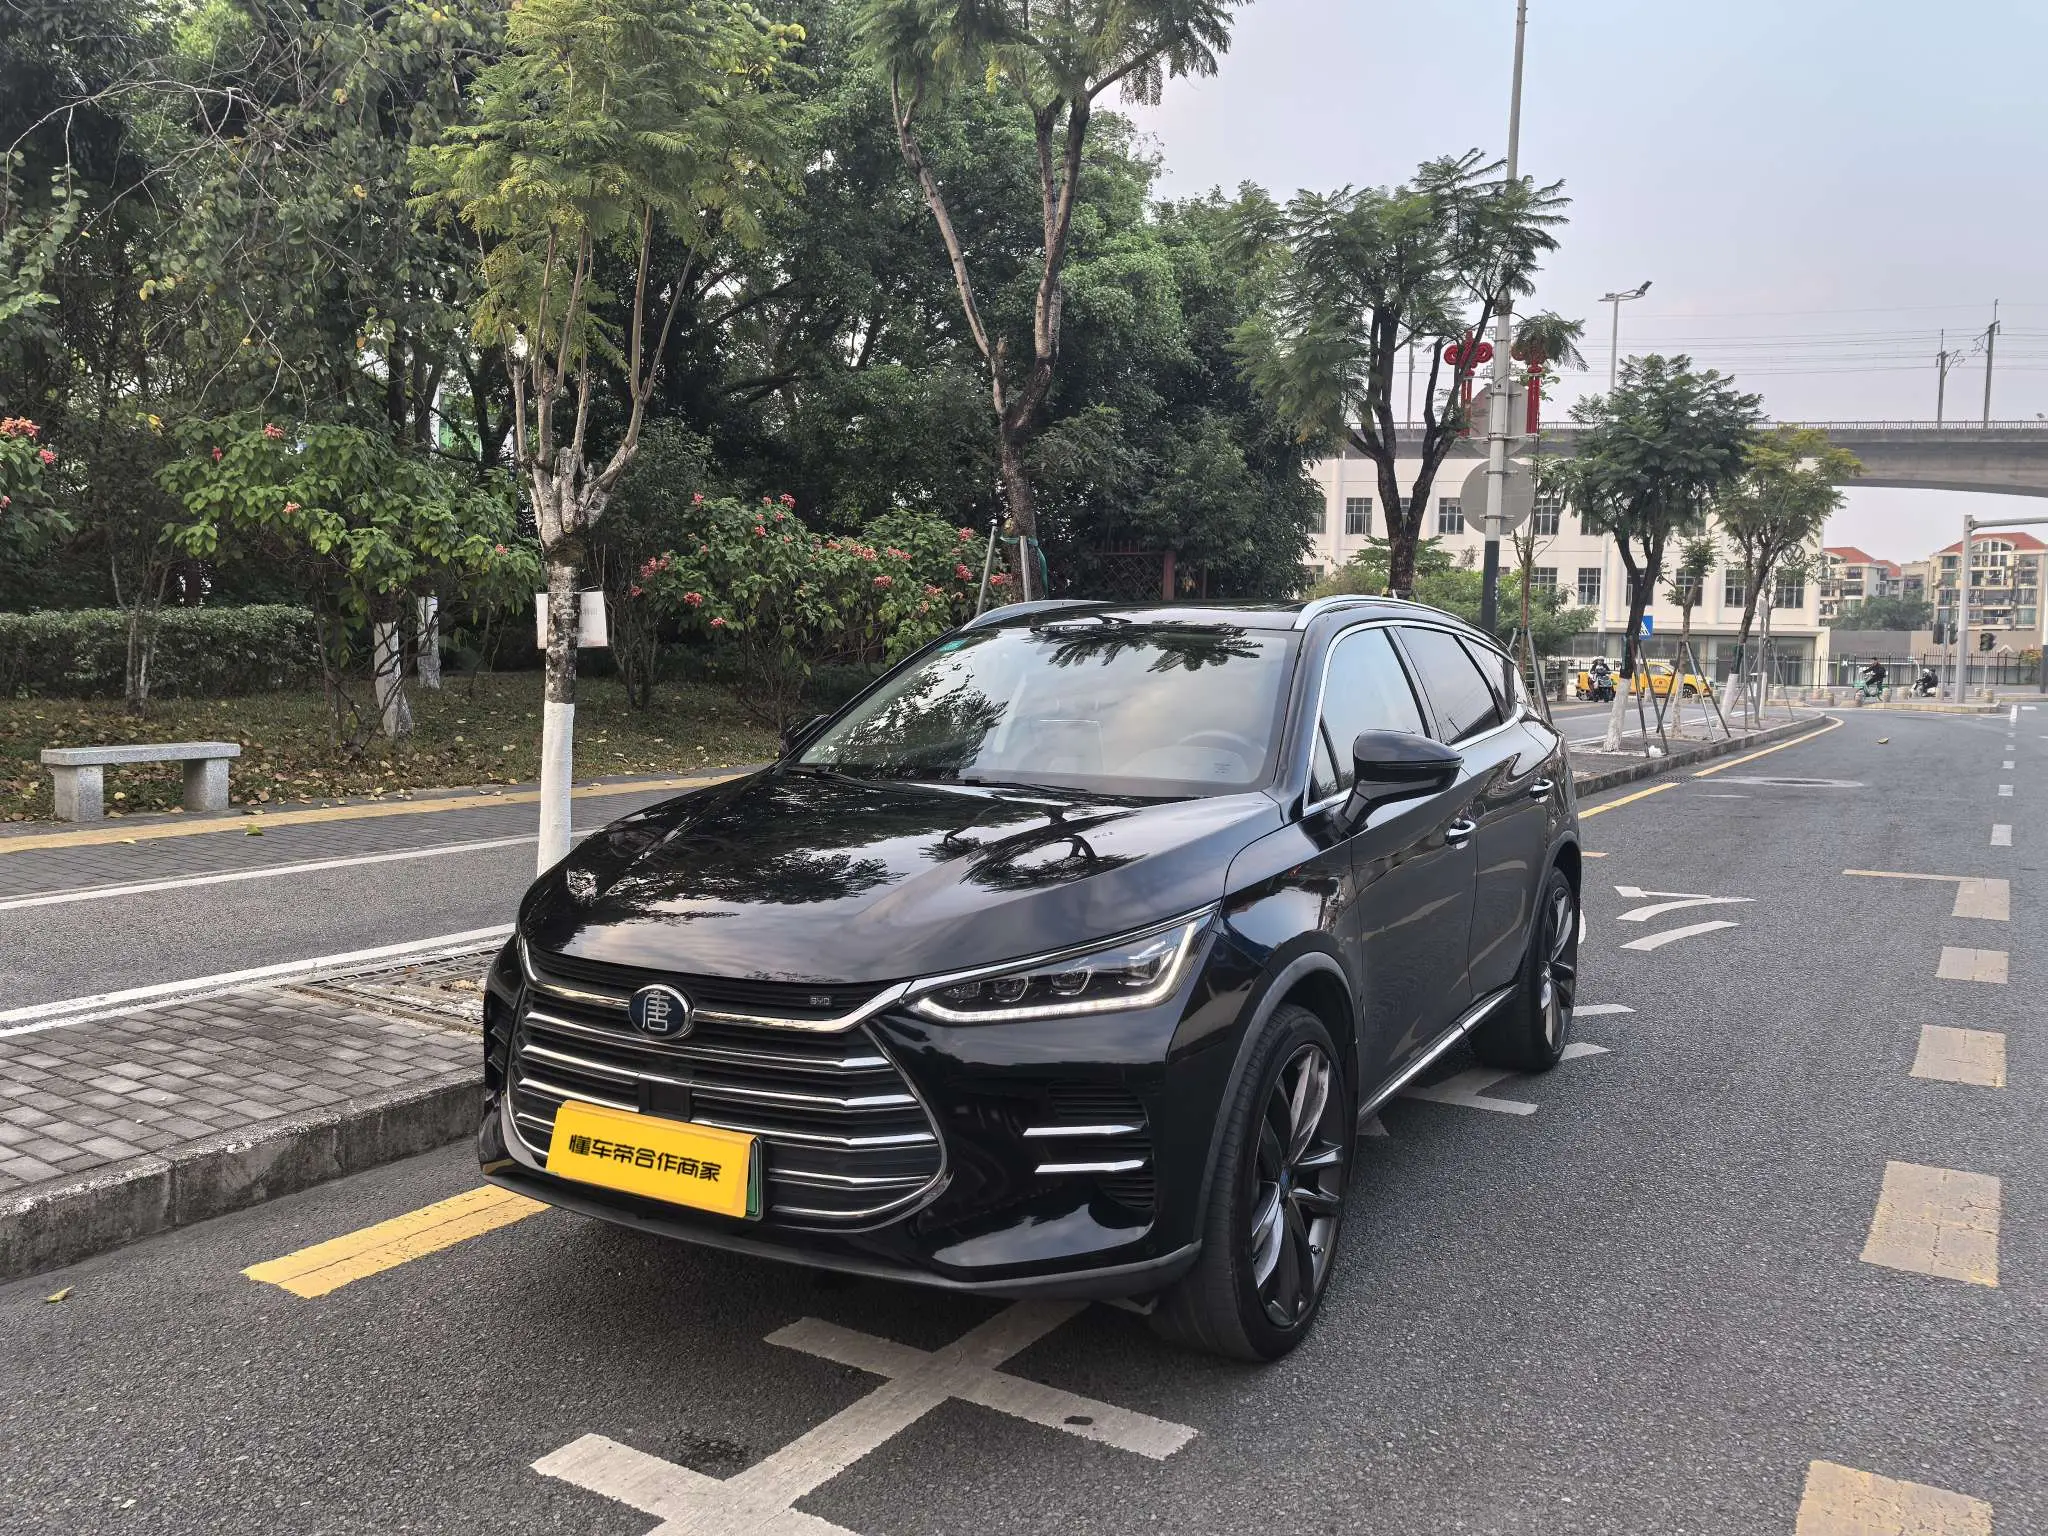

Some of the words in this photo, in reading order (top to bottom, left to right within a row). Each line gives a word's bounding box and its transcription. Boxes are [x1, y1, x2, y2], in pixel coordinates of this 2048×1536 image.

[810, 996, 831, 1006] BYD
[568, 1133, 722, 1183] 懂车帝合作商家
